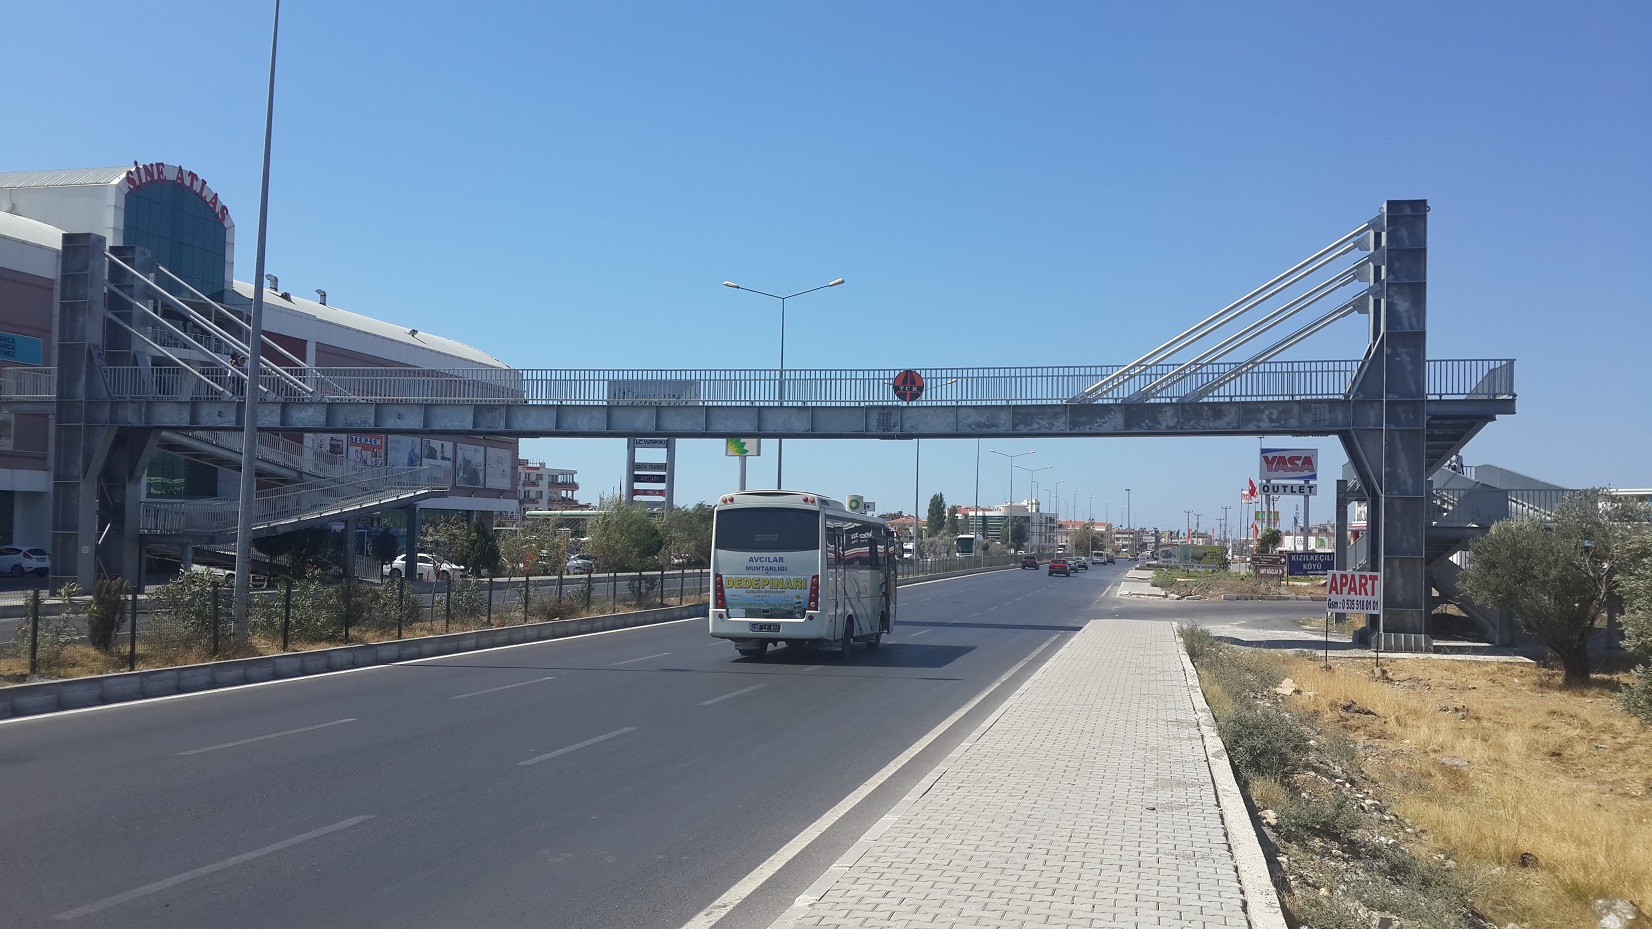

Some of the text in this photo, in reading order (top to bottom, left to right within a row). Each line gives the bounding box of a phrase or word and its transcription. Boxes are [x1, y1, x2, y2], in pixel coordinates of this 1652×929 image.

[125, 160, 229, 224] SİNE ATLAS
[351, 435, 381, 446] TEKZEN
[1262, 455, 1315, 473] YASA
[1262, 485, 1314, 494] OUTLET
[1291, 554, 1334, 563] KIZILKEÇİLİ
[1302, 562, 1322, 570] KÖYÜ
[725, 577, 807, 590] DEDEPINARI
[1328, 573, 1379, 597] APART
[1327, 598, 1338, 609] Gsm
